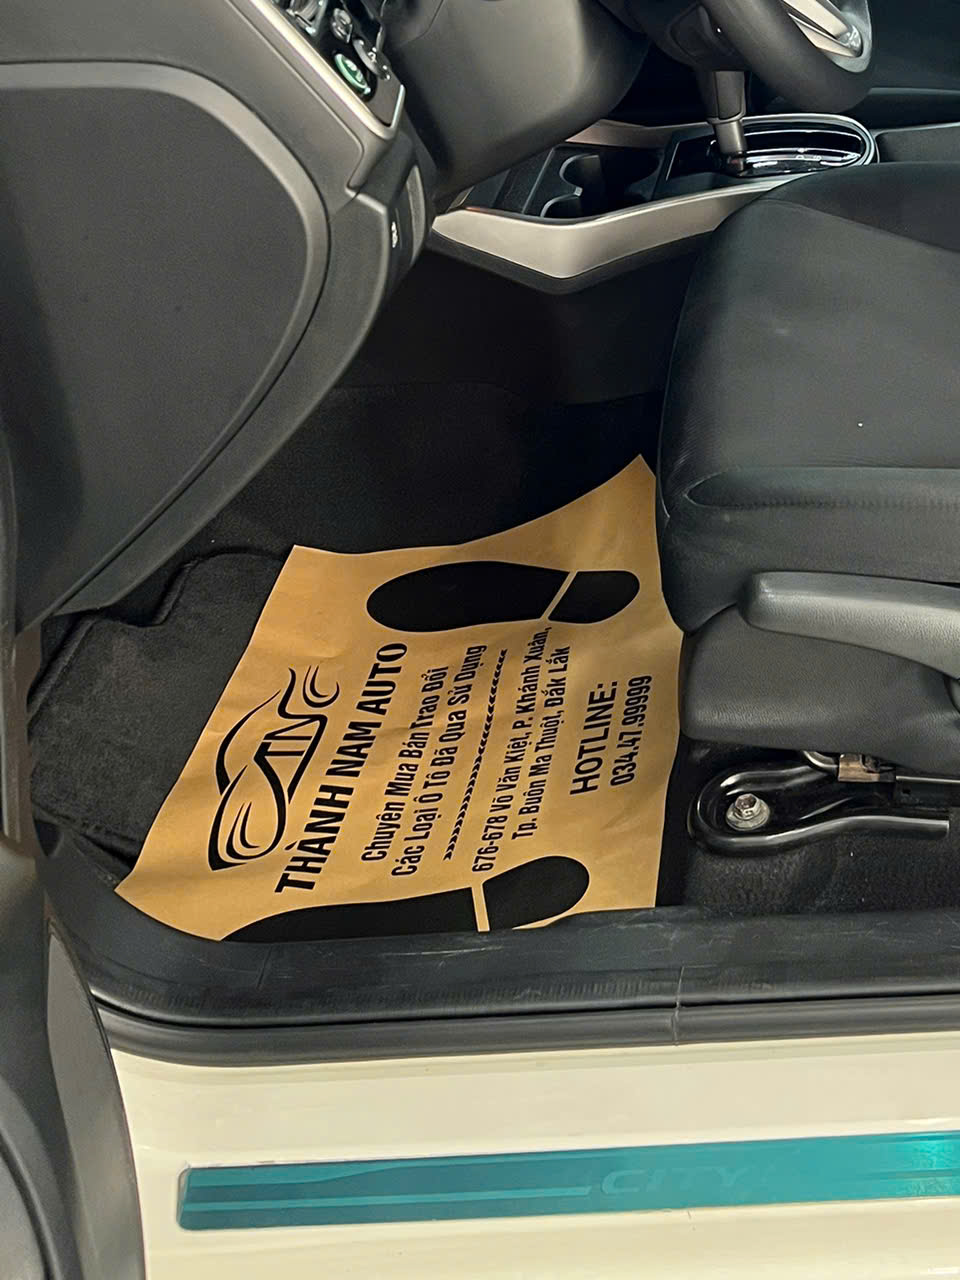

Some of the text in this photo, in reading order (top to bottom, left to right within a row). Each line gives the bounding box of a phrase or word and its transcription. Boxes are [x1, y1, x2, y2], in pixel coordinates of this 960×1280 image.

[274, 642, 408, 893] THÀNH NAM AUTO
[361, 666, 449, 861] Chuyên Mua Bán Trao Đổi
[391, 645, 487, 876] Các Loại Ô Tô Đã Qua Sử Dụng
[472, 626, 552, 873] 676-678 Võ Văn Kiệt, P. Khánh Xuân,
[529, 754, 552, 778] Ma
[535, 709, 565, 753] Thuột,
[569, 681, 617, 795] HOTLINE:
[610, 675, 652, 786] 034.47.99999
[511, 817, 538, 840] Tp.
[518, 779, 547, 816] Buôn
